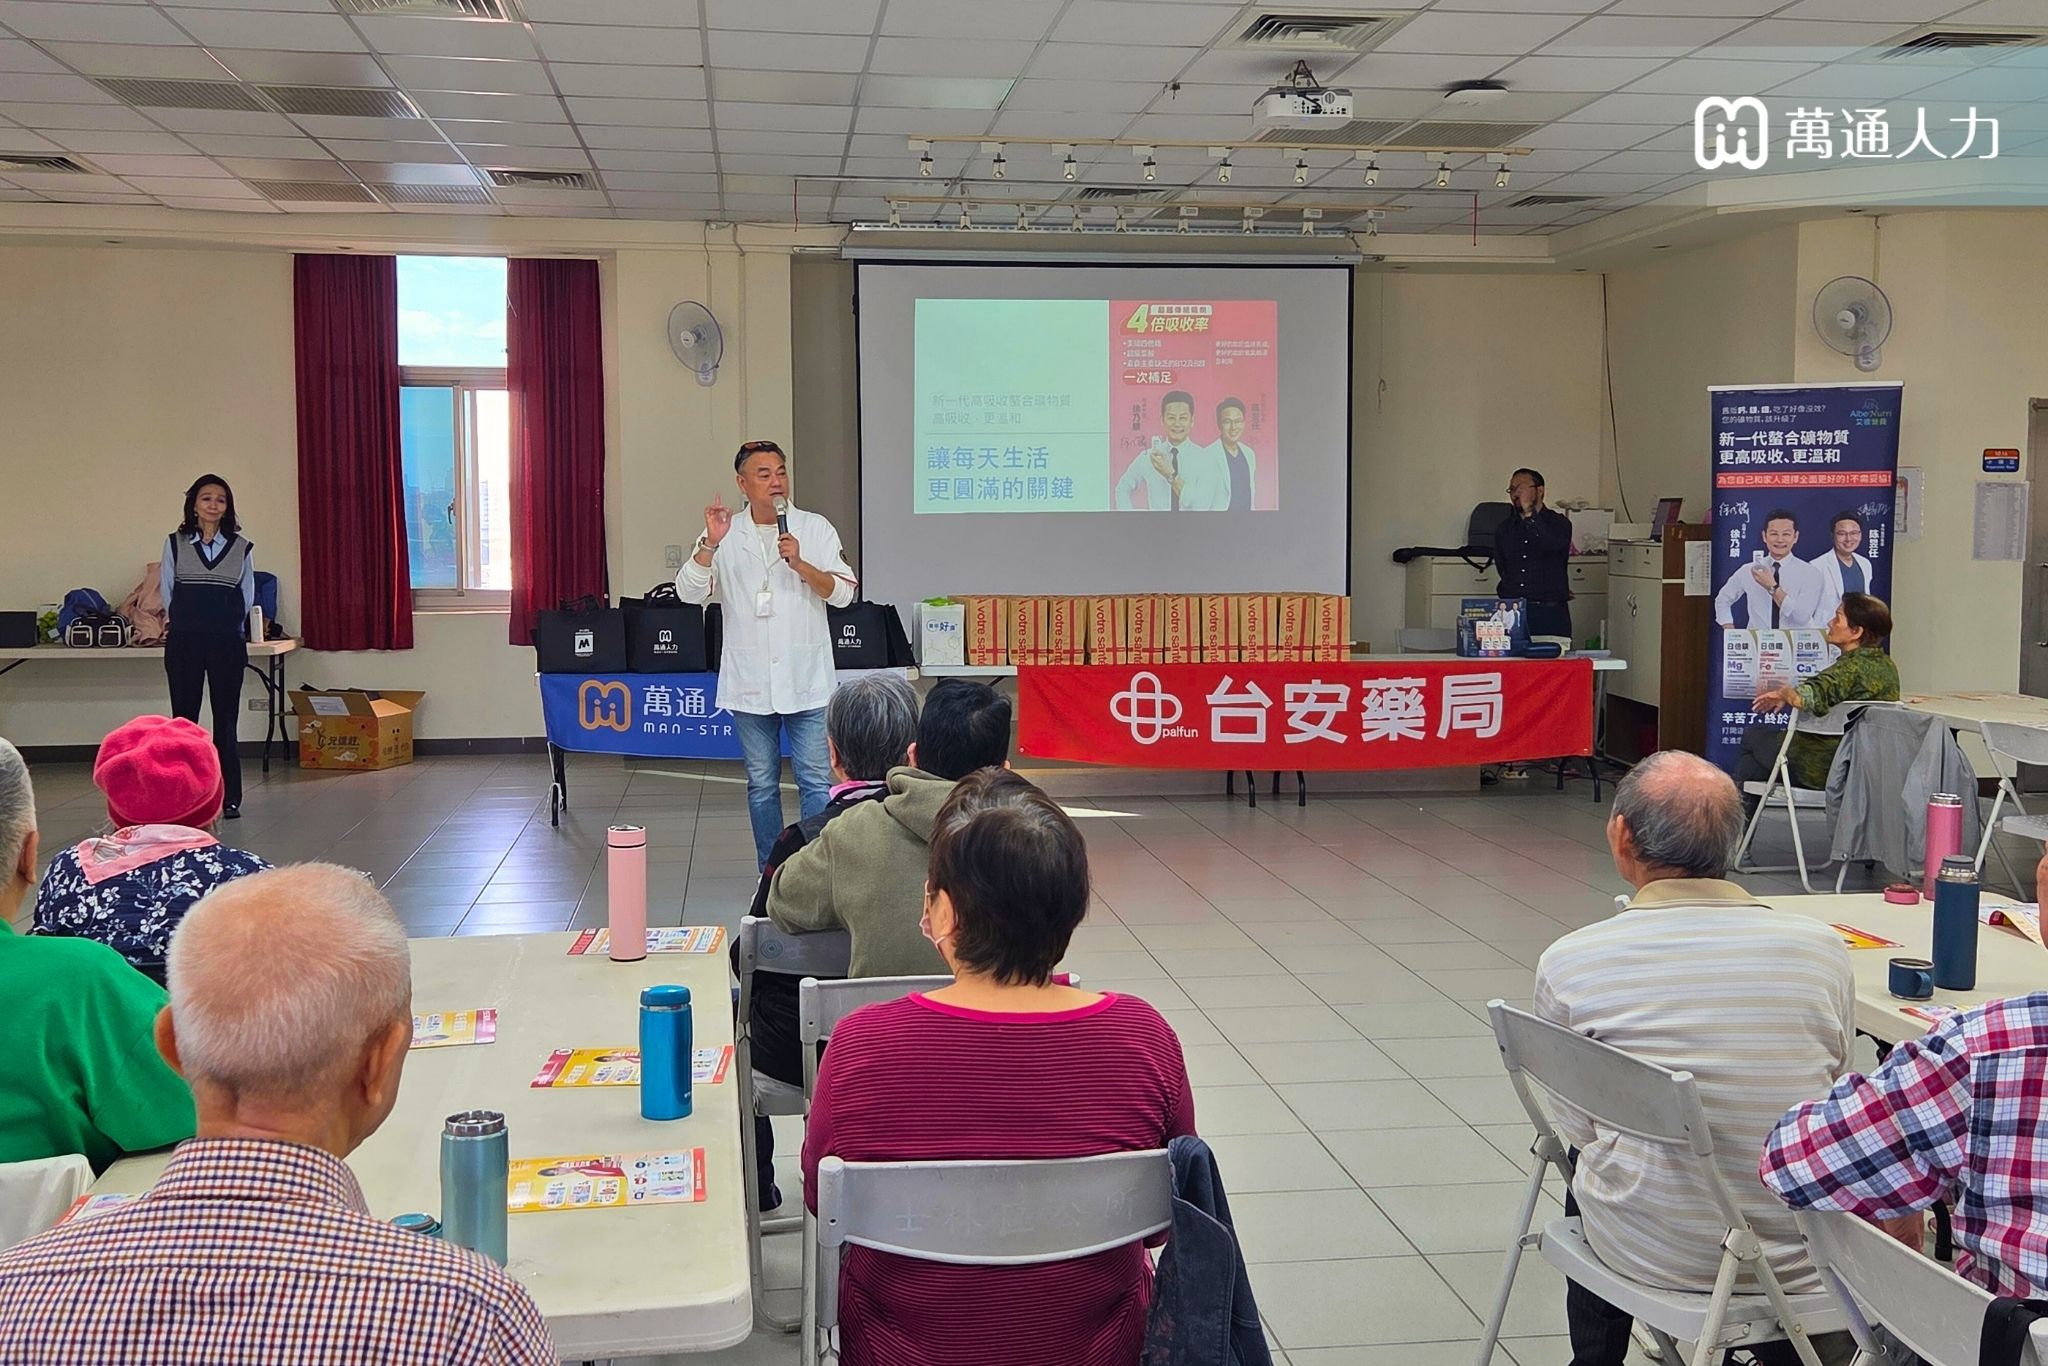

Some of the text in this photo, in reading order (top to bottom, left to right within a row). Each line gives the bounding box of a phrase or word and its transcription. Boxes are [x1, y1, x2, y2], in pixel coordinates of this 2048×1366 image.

[1124, 371, 1172, 384] 一次補足
[1719, 430, 1849, 447] 新一代螯合礦物質
[928, 445, 1049, 470] 讓每天生活
[1719, 449, 1841, 465] 更高吸收、更溫和
[928, 476, 1074, 501] 更圓滿的關鍵
[1729, 529, 1740, 558] 徐乃麟
[978, 606, 987, 634] votre
[1019, 607, 1028, 635] votre
[1056, 607, 1064, 635] votre
[1097, 605, 1106, 634] votre
[1135, 605, 1144, 633] votre
[1171, 604, 1180, 632] votre
[1209, 603, 1218, 632] votre
[1248, 603, 1257, 632] votre
[1285, 603, 1295, 632] votre
[1321, 603, 1330, 631] votre
[1727, 661, 1743, 671] Mg
[1760, 662, 1772, 670] Fe
[1205, 672, 1504, 745] 台安藥局
[1722, 712, 1791, 725] 辛苦了、終於
[1162, 726, 1199, 740] palfun
